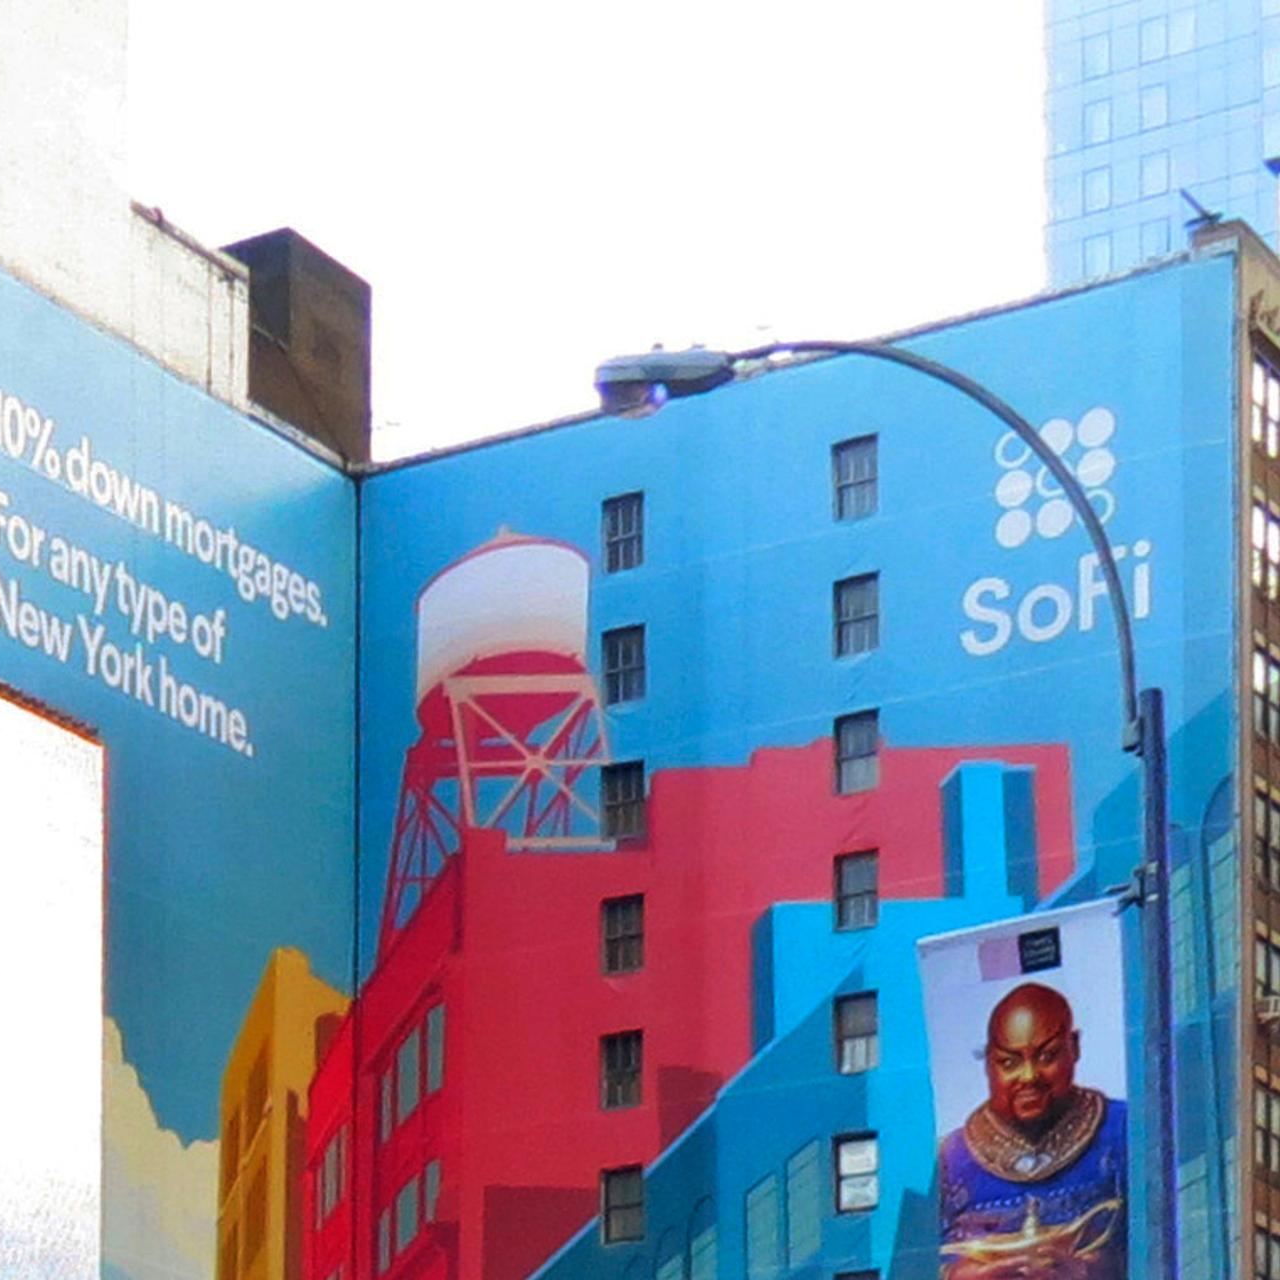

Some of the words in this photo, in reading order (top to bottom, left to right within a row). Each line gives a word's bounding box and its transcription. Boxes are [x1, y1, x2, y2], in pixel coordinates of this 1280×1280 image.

[65, 433, 160, 537] down
[165, 500, 329, 627] mortgages.
[960, 540, 1151, 657] SoFi
[49, 536, 118, 617] any
[116, 558, 188, 646] type
[191, 608, 228, 666] of
[77, 614, 153, 709] York
[159, 655, 255, 758] home.
